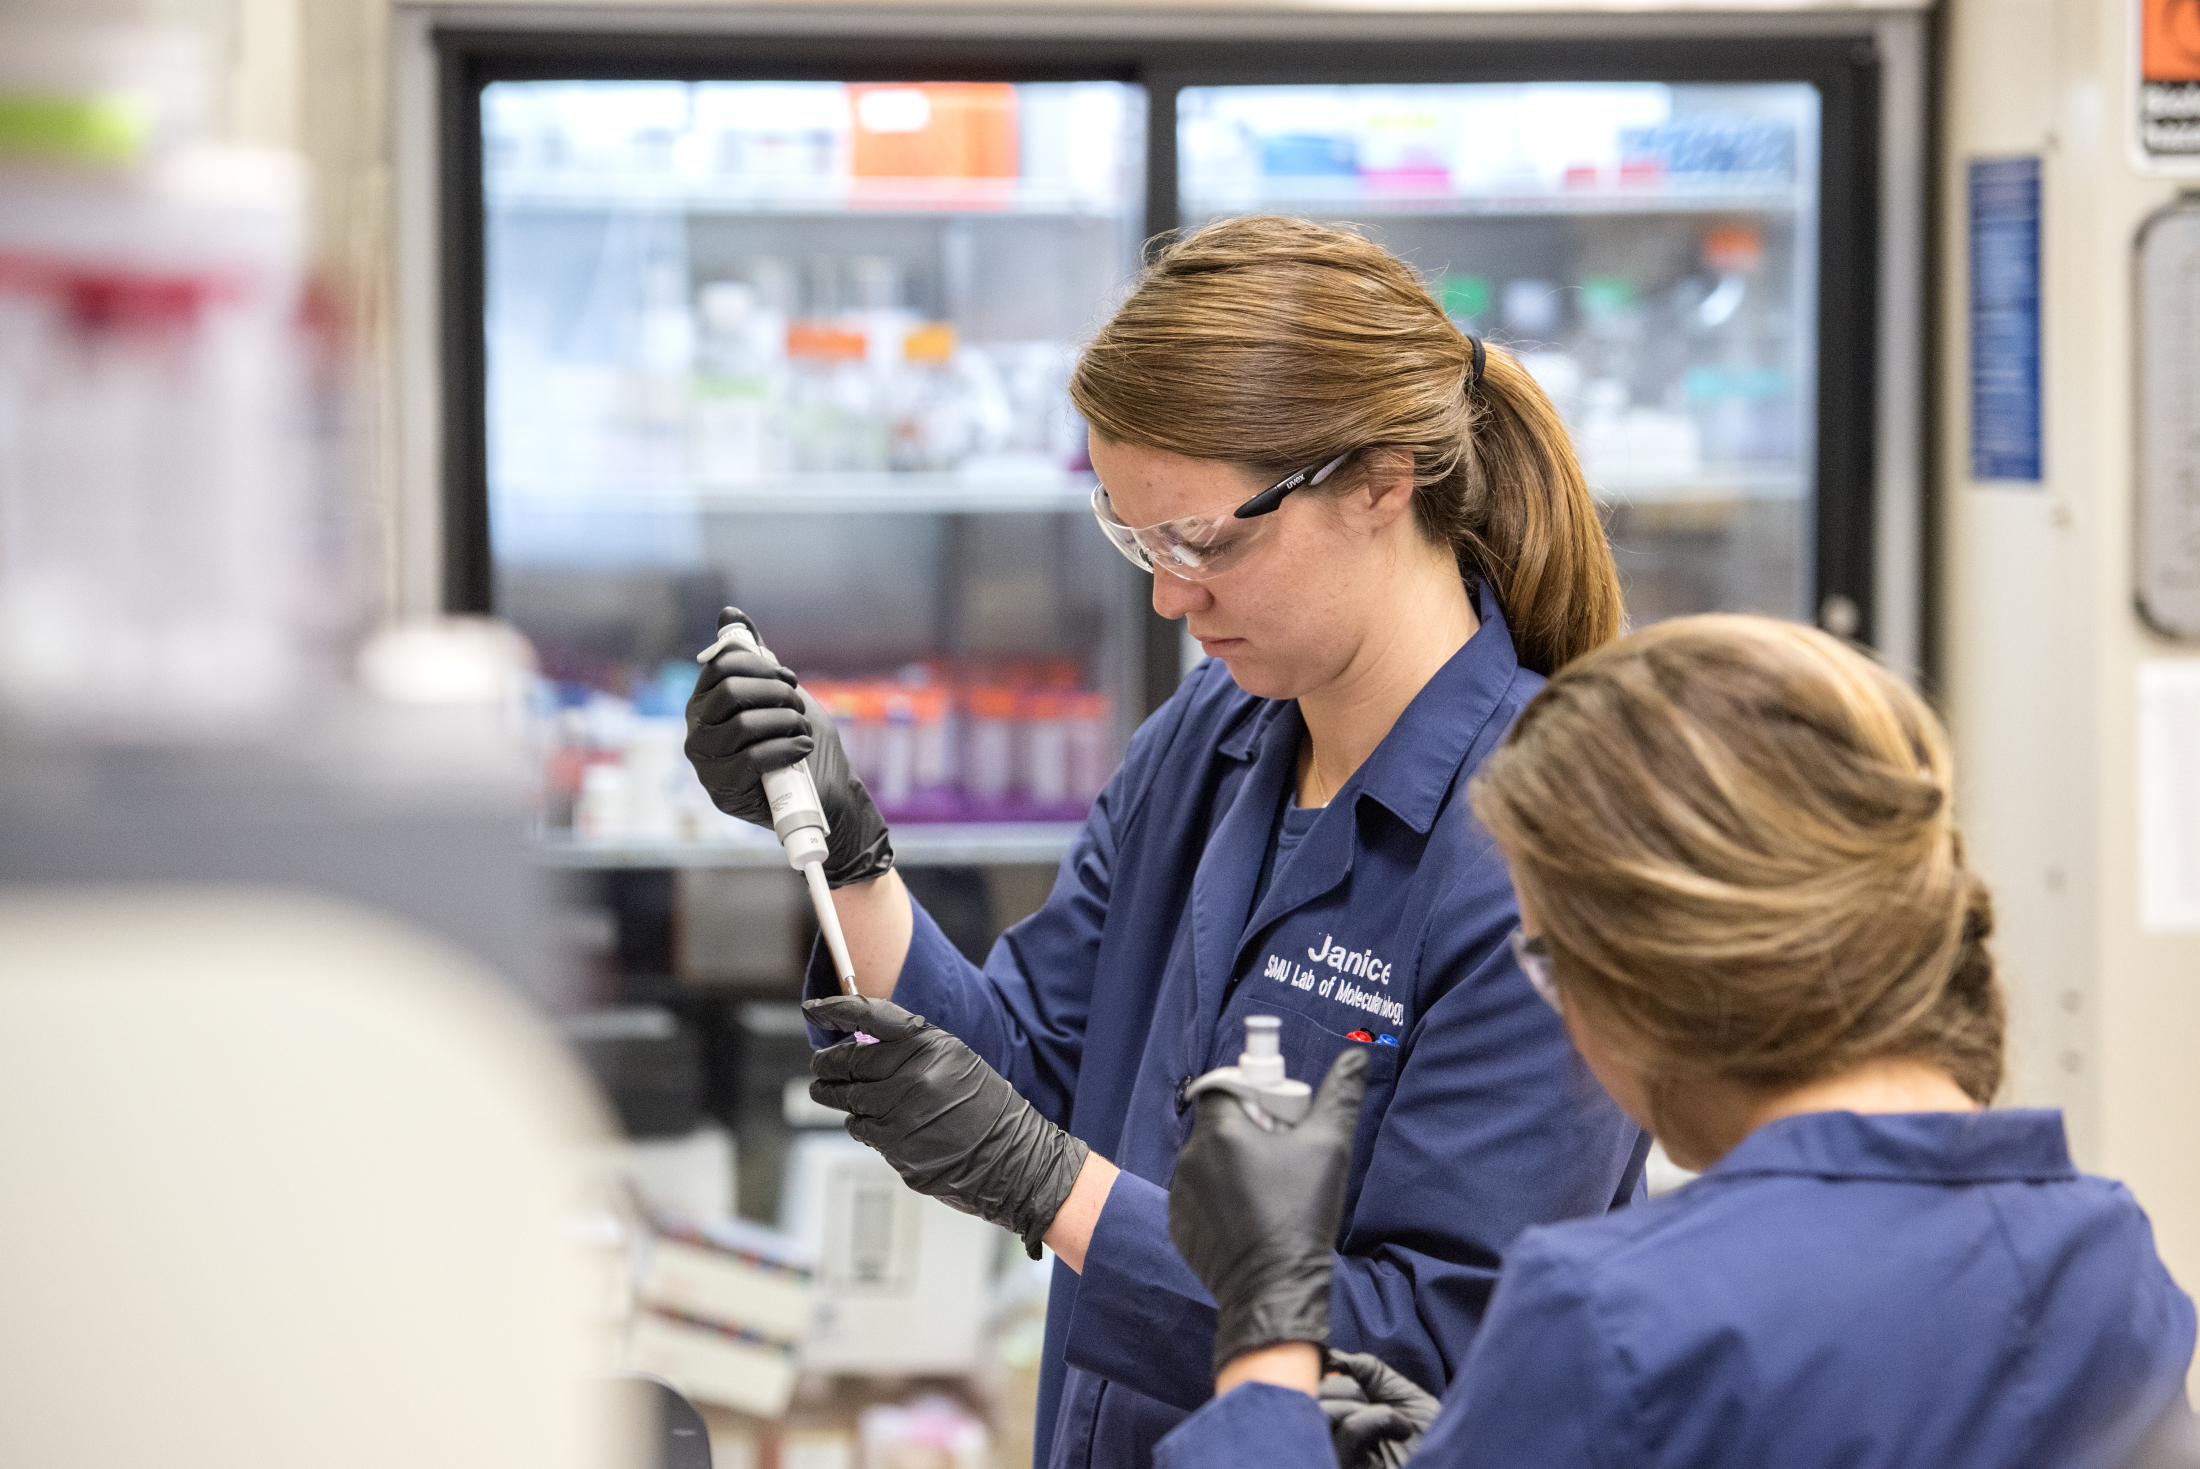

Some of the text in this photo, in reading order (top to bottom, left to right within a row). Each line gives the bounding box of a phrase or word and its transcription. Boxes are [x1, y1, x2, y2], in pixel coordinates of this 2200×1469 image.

[1286, 474, 1305, 489] uvex
[1264, 954, 1292, 983] SMU
[1290, 964, 1316, 991] Lab
[1318, 975, 1337, 998] of
[1335, 978, 1383, 1015] Molecular
[1307, 933, 1392, 985] Janice
